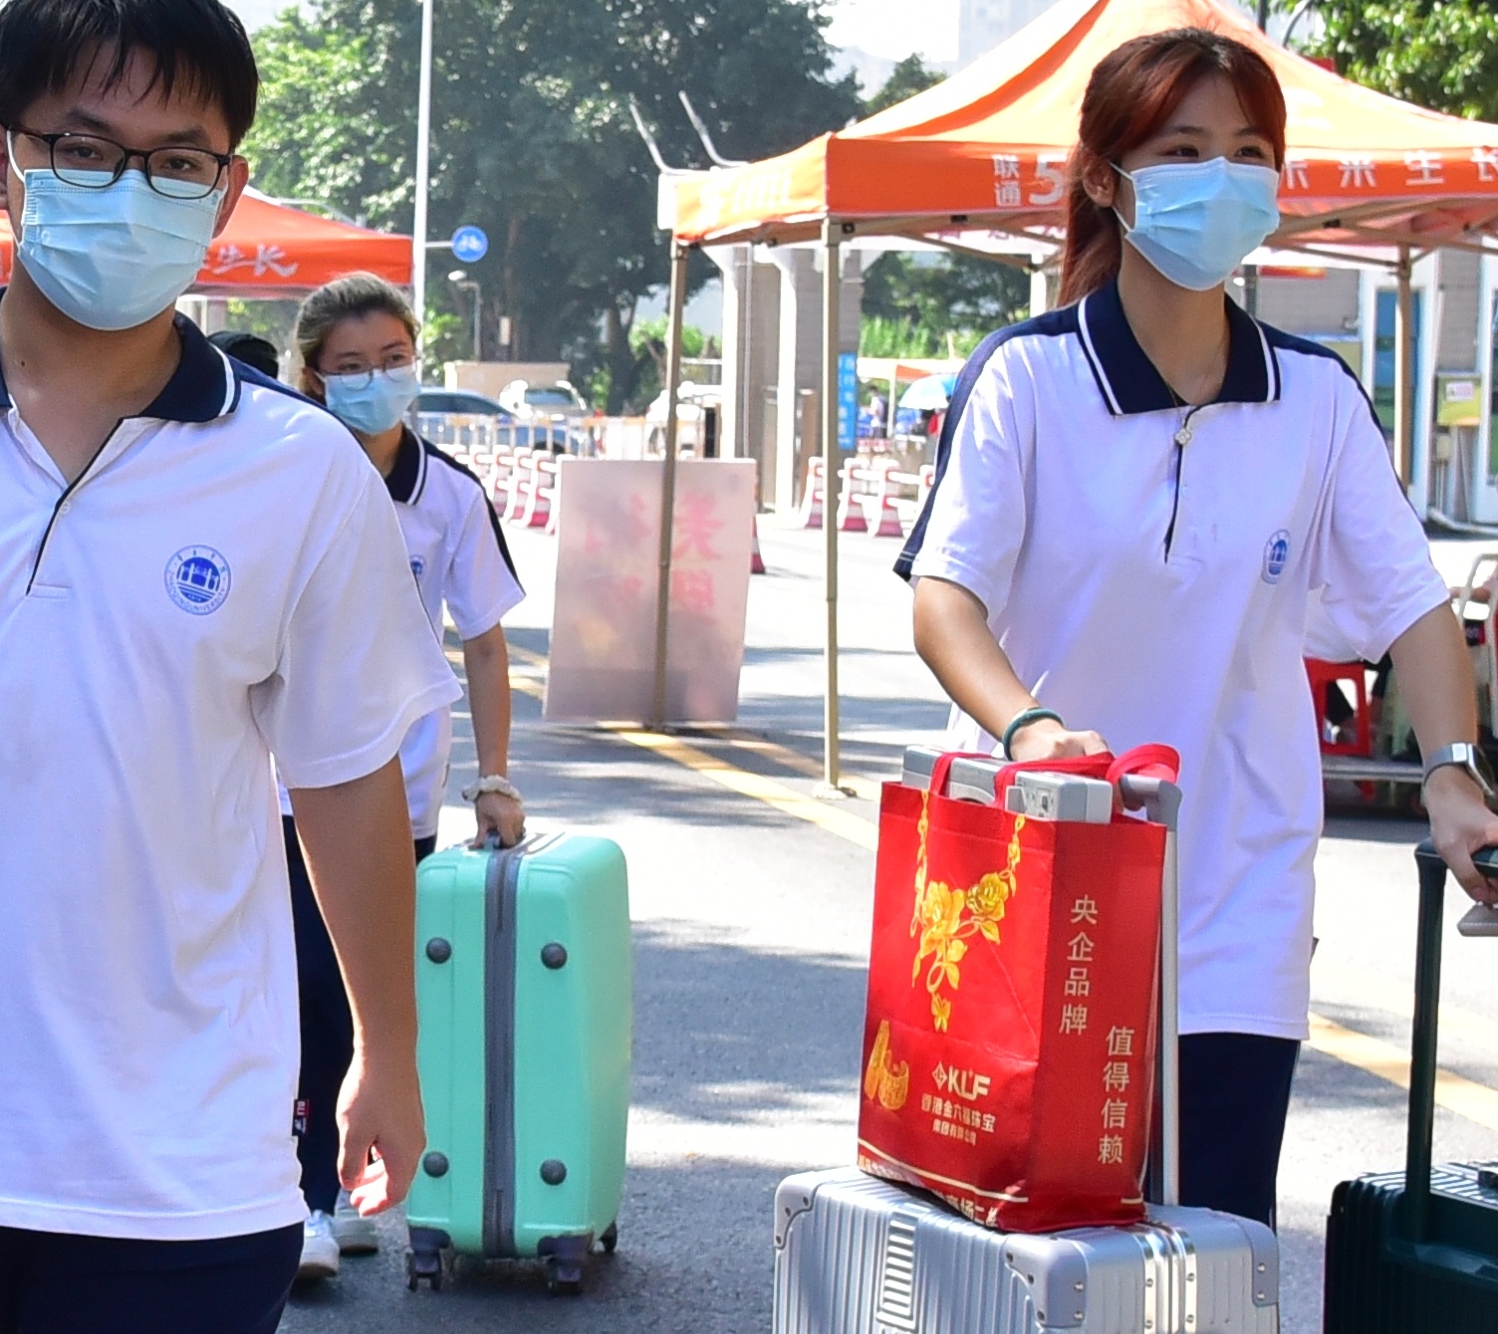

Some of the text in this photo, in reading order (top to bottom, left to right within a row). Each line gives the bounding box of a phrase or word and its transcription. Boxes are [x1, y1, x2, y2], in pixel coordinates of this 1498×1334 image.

[204, 243, 301, 278] 生长
[1058, 895, 1100, 1036] 央企品牌
[1097, 1025, 1136, 1165] 值得信赖
